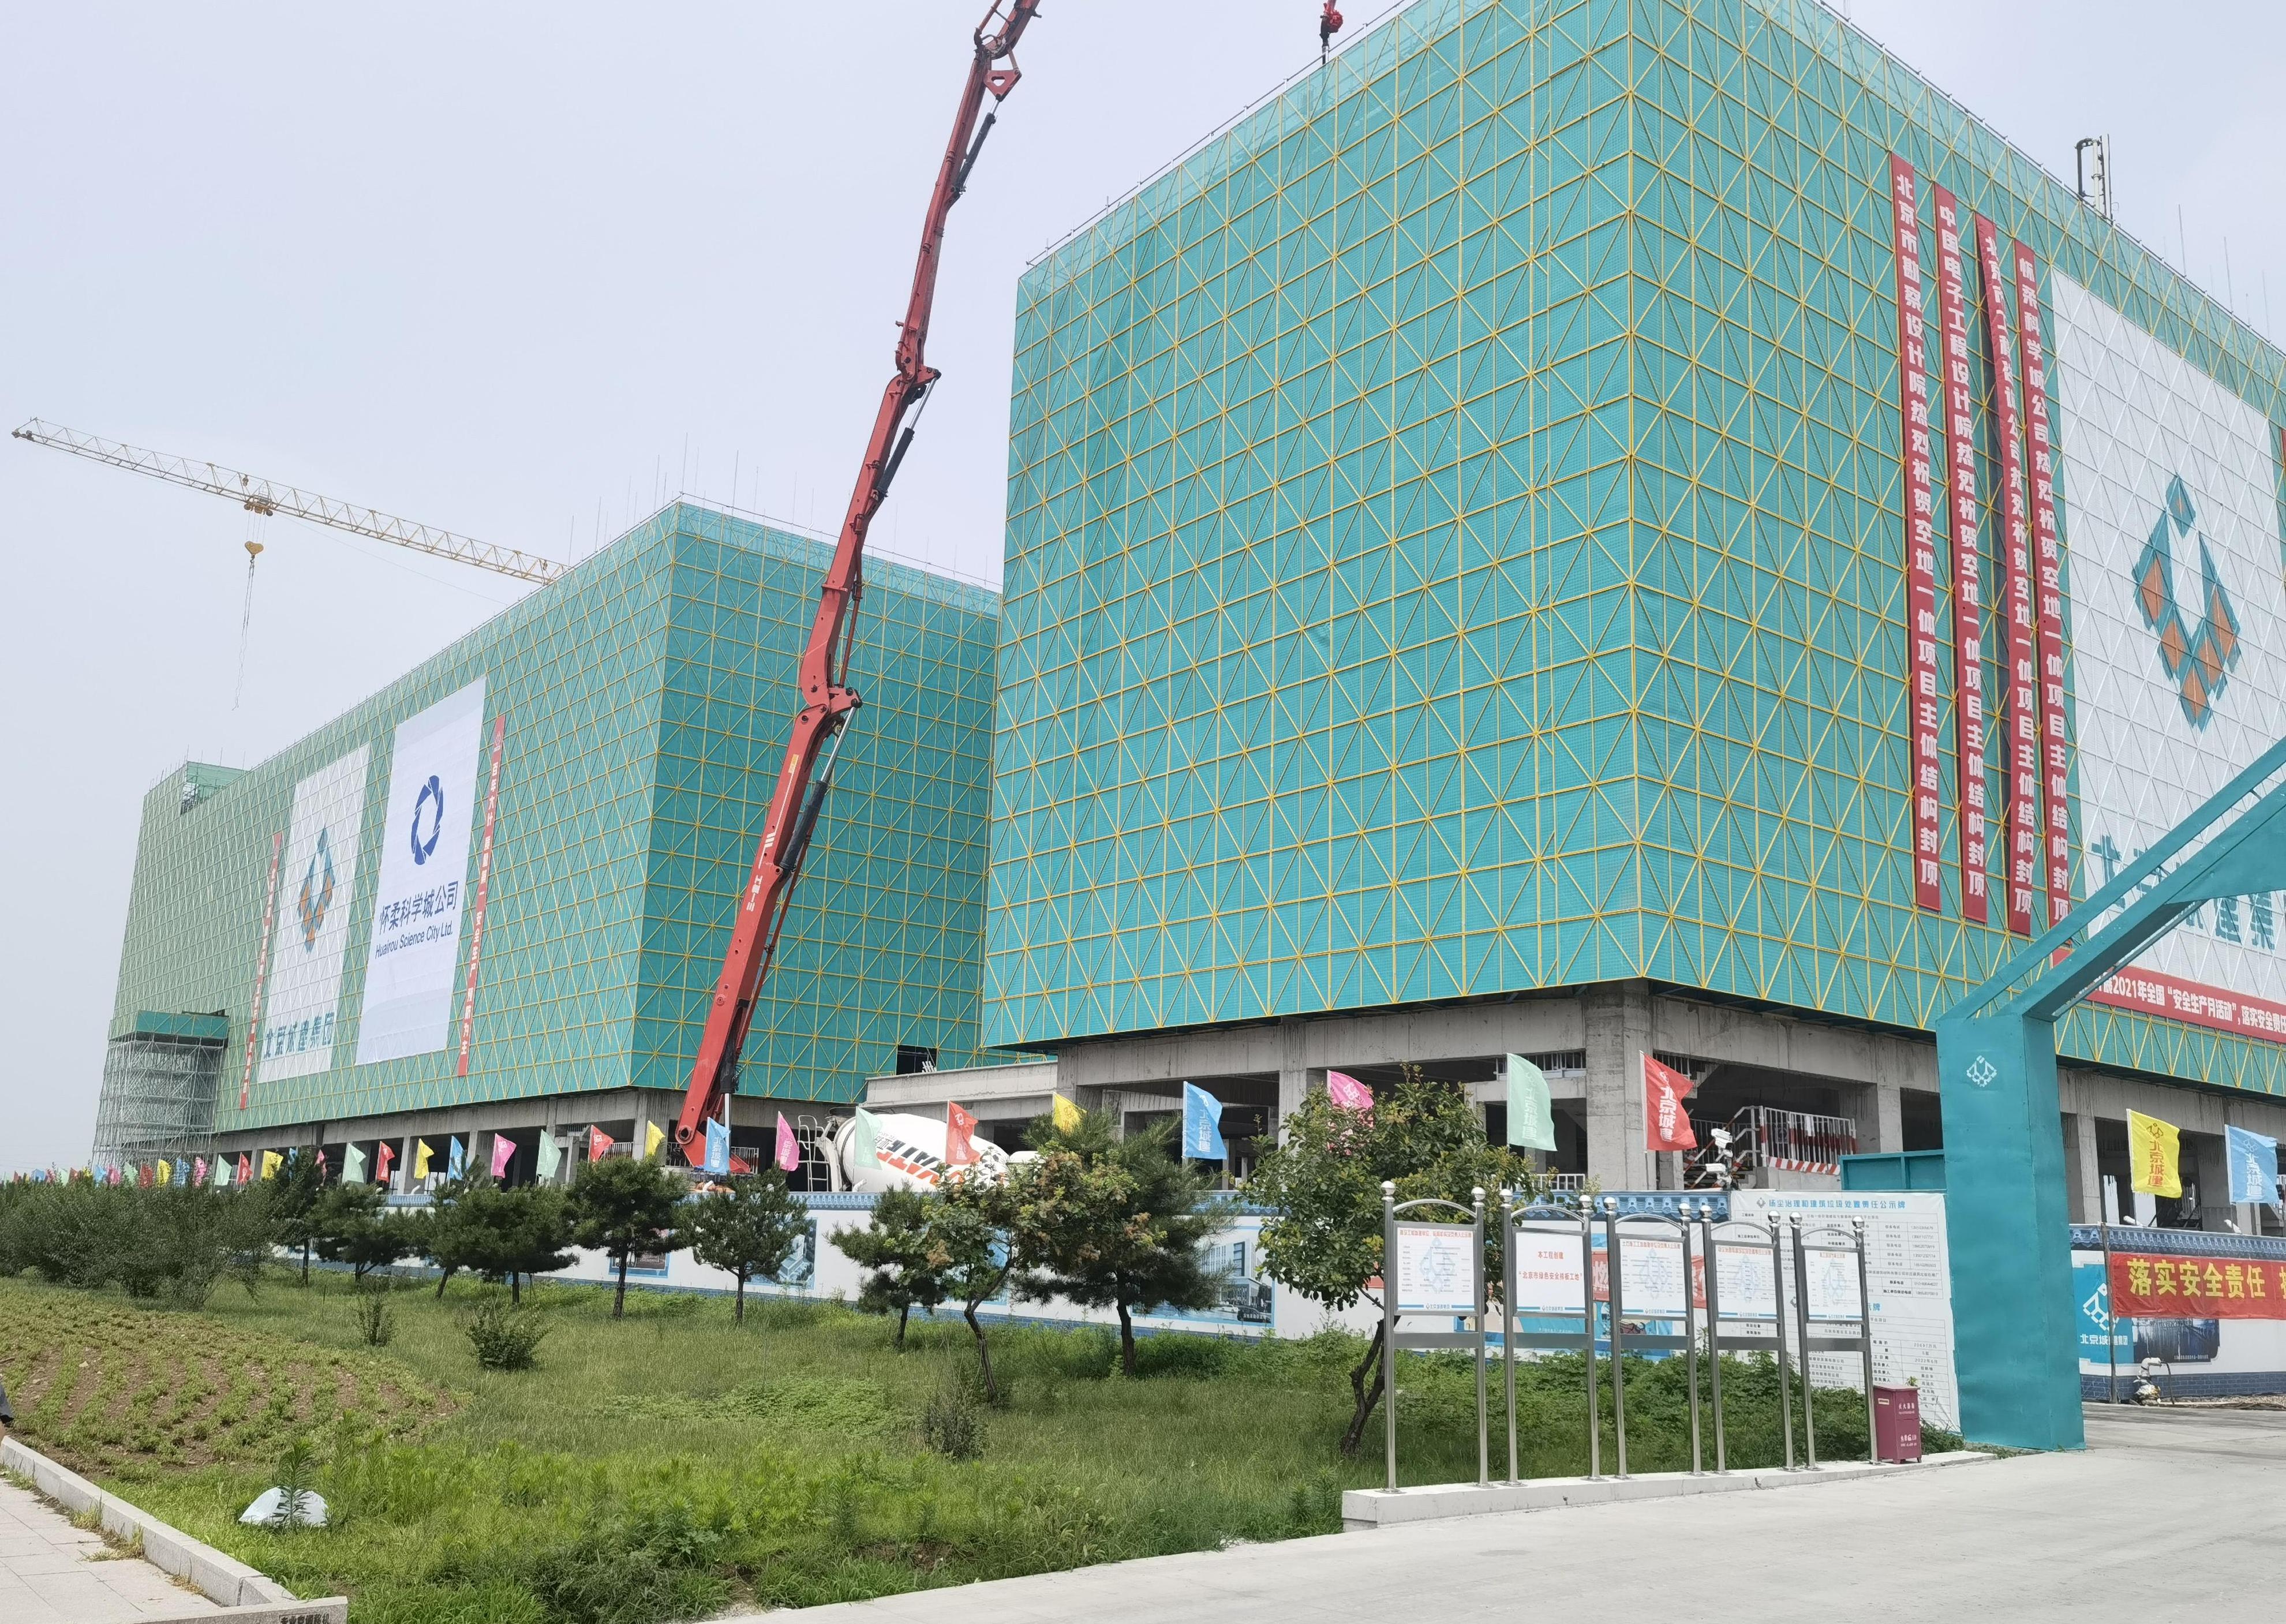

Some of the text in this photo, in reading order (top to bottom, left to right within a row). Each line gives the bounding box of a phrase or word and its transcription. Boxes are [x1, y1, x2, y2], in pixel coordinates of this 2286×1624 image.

[1896, 173, 1938, 888] 北京市勘察设计院热烈祝贺空地一体项目主体结构封顶
[1940, 205, 1985, 899] 中国电子工程设计院热烈祝贺空地一体项目主体结构封顶
[2019, 257, 2070, 921] 怀柔科学城公司热烈祝贺空地一体项目主体结构封顶
[379, 881, 458, 936] 怀柔科学城公司
[375, 920, 453, 959] Huairou Science City Ltd.
[1658, 1085, 1678, 1142] 北京城建
[2147, 1140, 2165, 1187] 北京城建
[2246, 1152, 2265, 1199] 北京城建
[1537, 1251, 1564, 1260] 本工程创建
[2127, 1258, 2266, 1299] 落实安全责任
[2080, 1333, 2128, 1346] 北京城建集团
